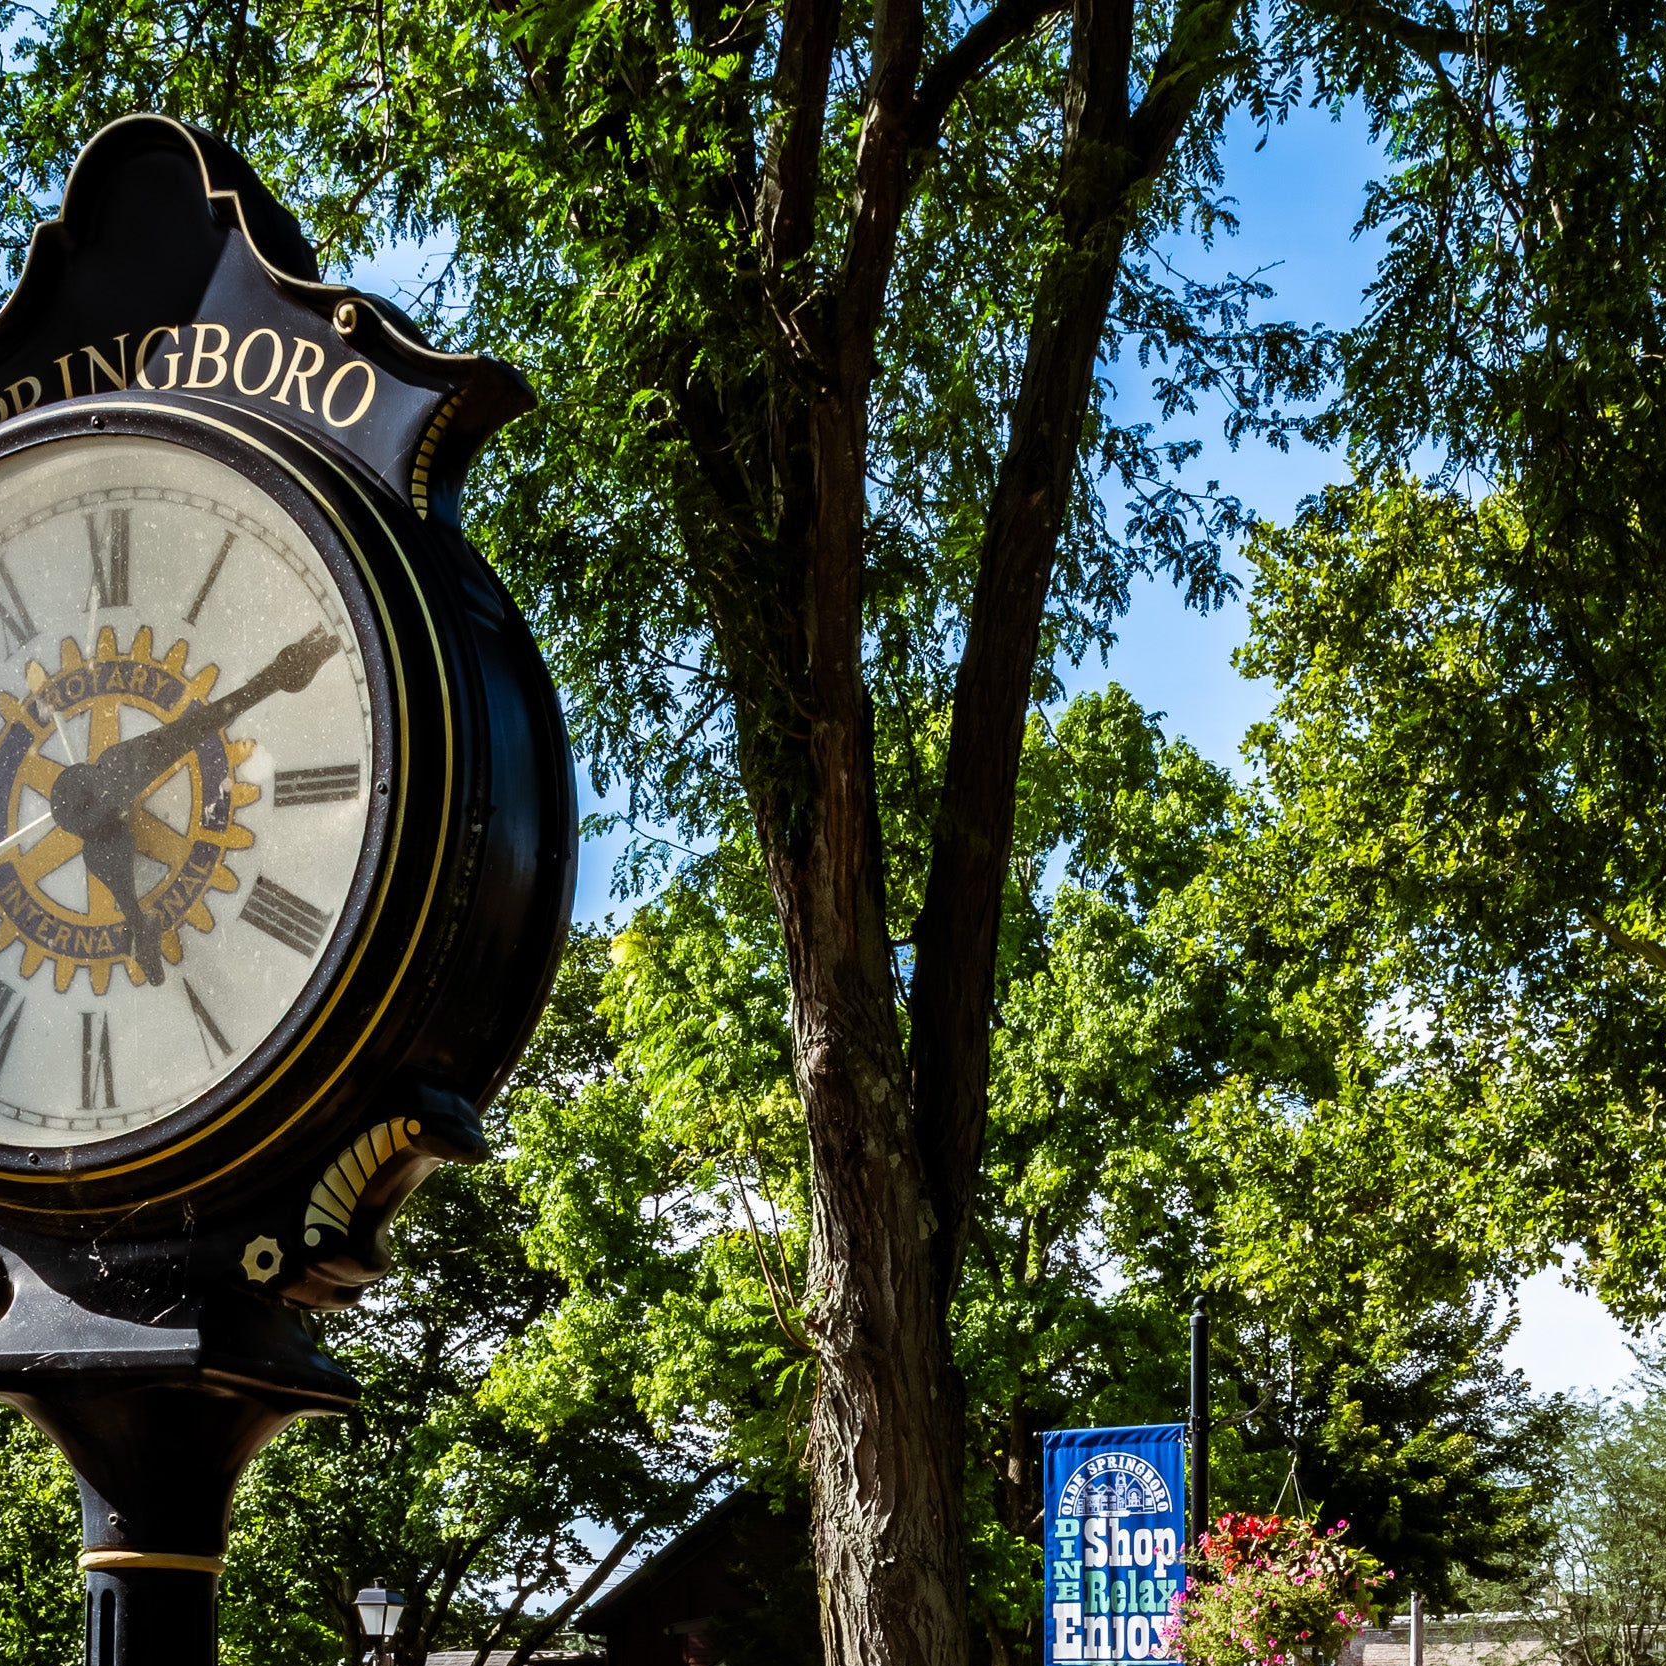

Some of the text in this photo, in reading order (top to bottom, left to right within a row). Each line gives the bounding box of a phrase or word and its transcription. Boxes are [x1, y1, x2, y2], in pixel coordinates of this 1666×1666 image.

[46, 667, 174, 706] ROTARY
[1061, 1456, 1169, 1516] OLDE SPRINGBORO
[1053, 1518, 1082, 1601] DINE
[1084, 1517, 1177, 1578] Shop
[1084, 1571, 1177, 1613] Relax
